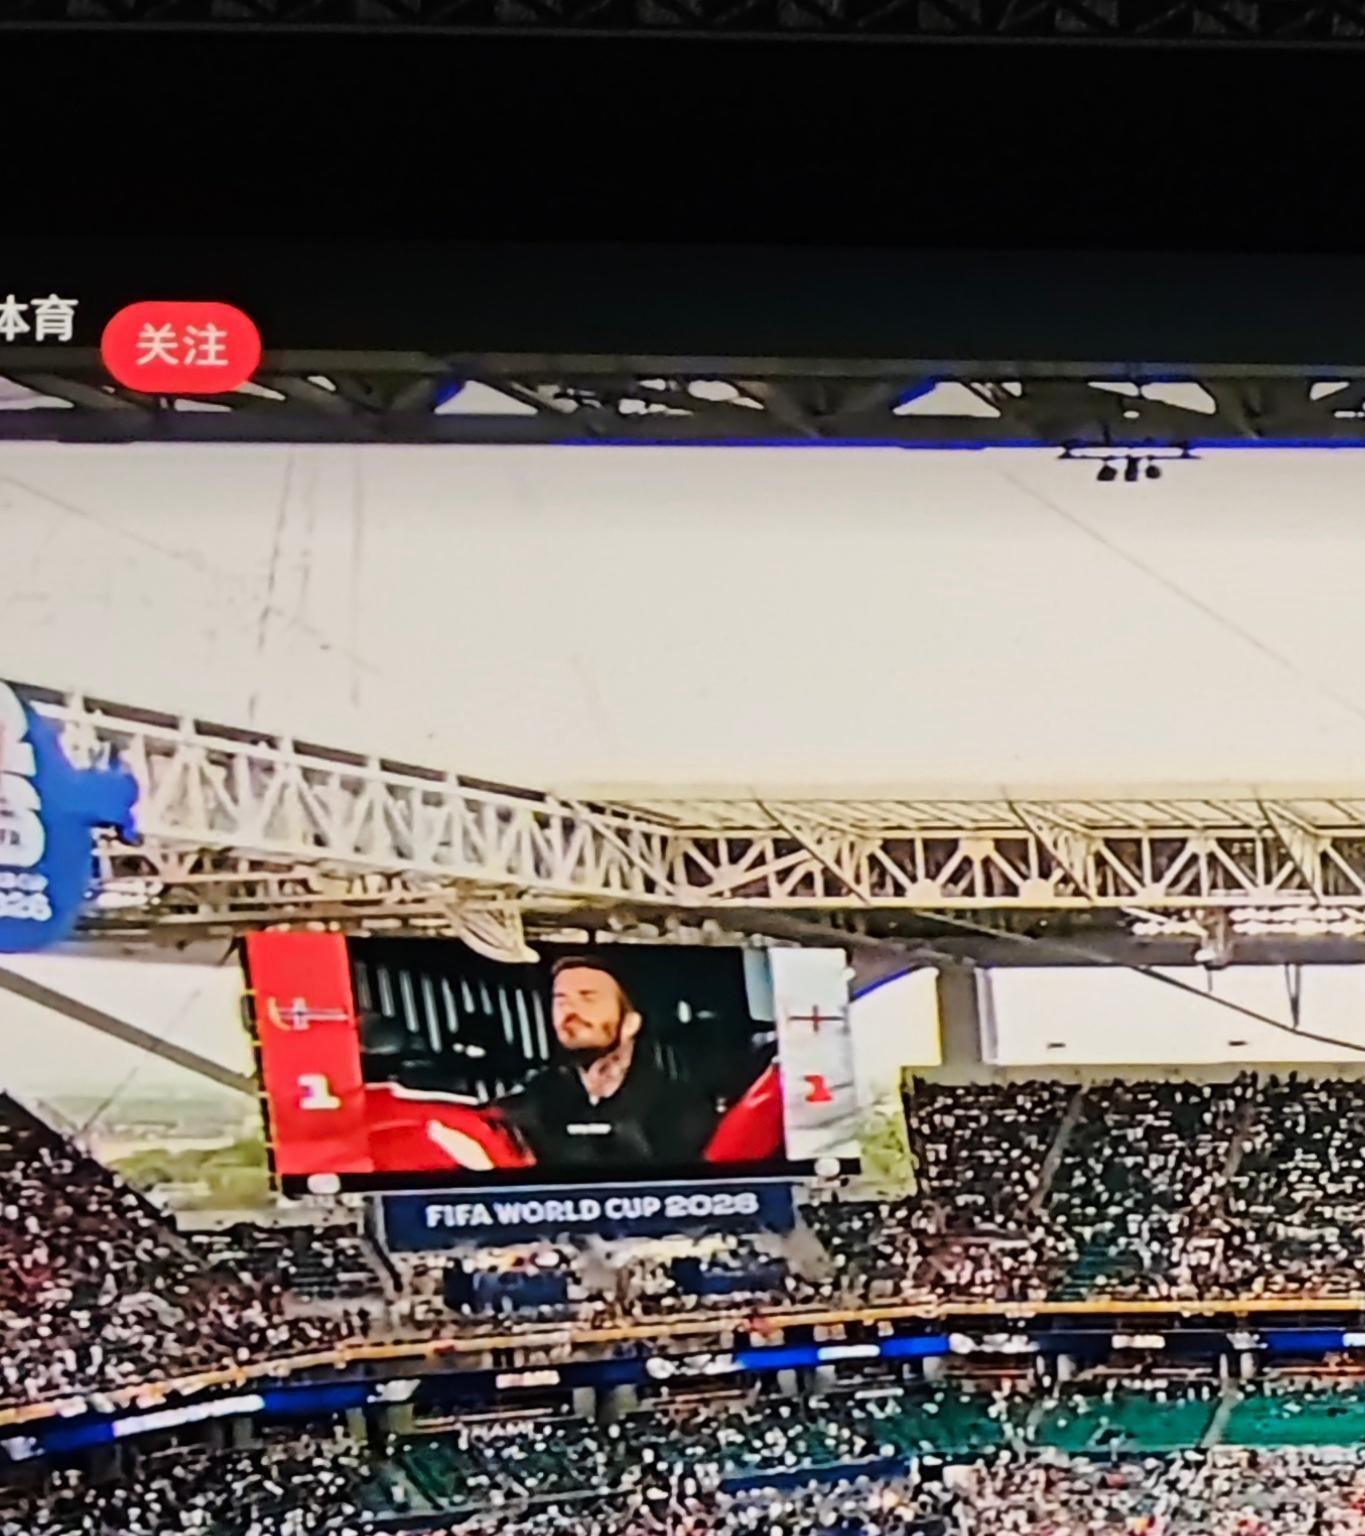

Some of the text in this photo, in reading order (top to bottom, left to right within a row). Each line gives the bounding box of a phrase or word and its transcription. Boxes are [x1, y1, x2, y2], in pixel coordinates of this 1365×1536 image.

[136, 322, 229, 366] 关注
[297, 1073, 341, 1110] 1
[425, 1202, 493, 1228] FIFA
[494, 1196, 601, 1226] WORLD
[604, 1197, 661, 1221] CUP
